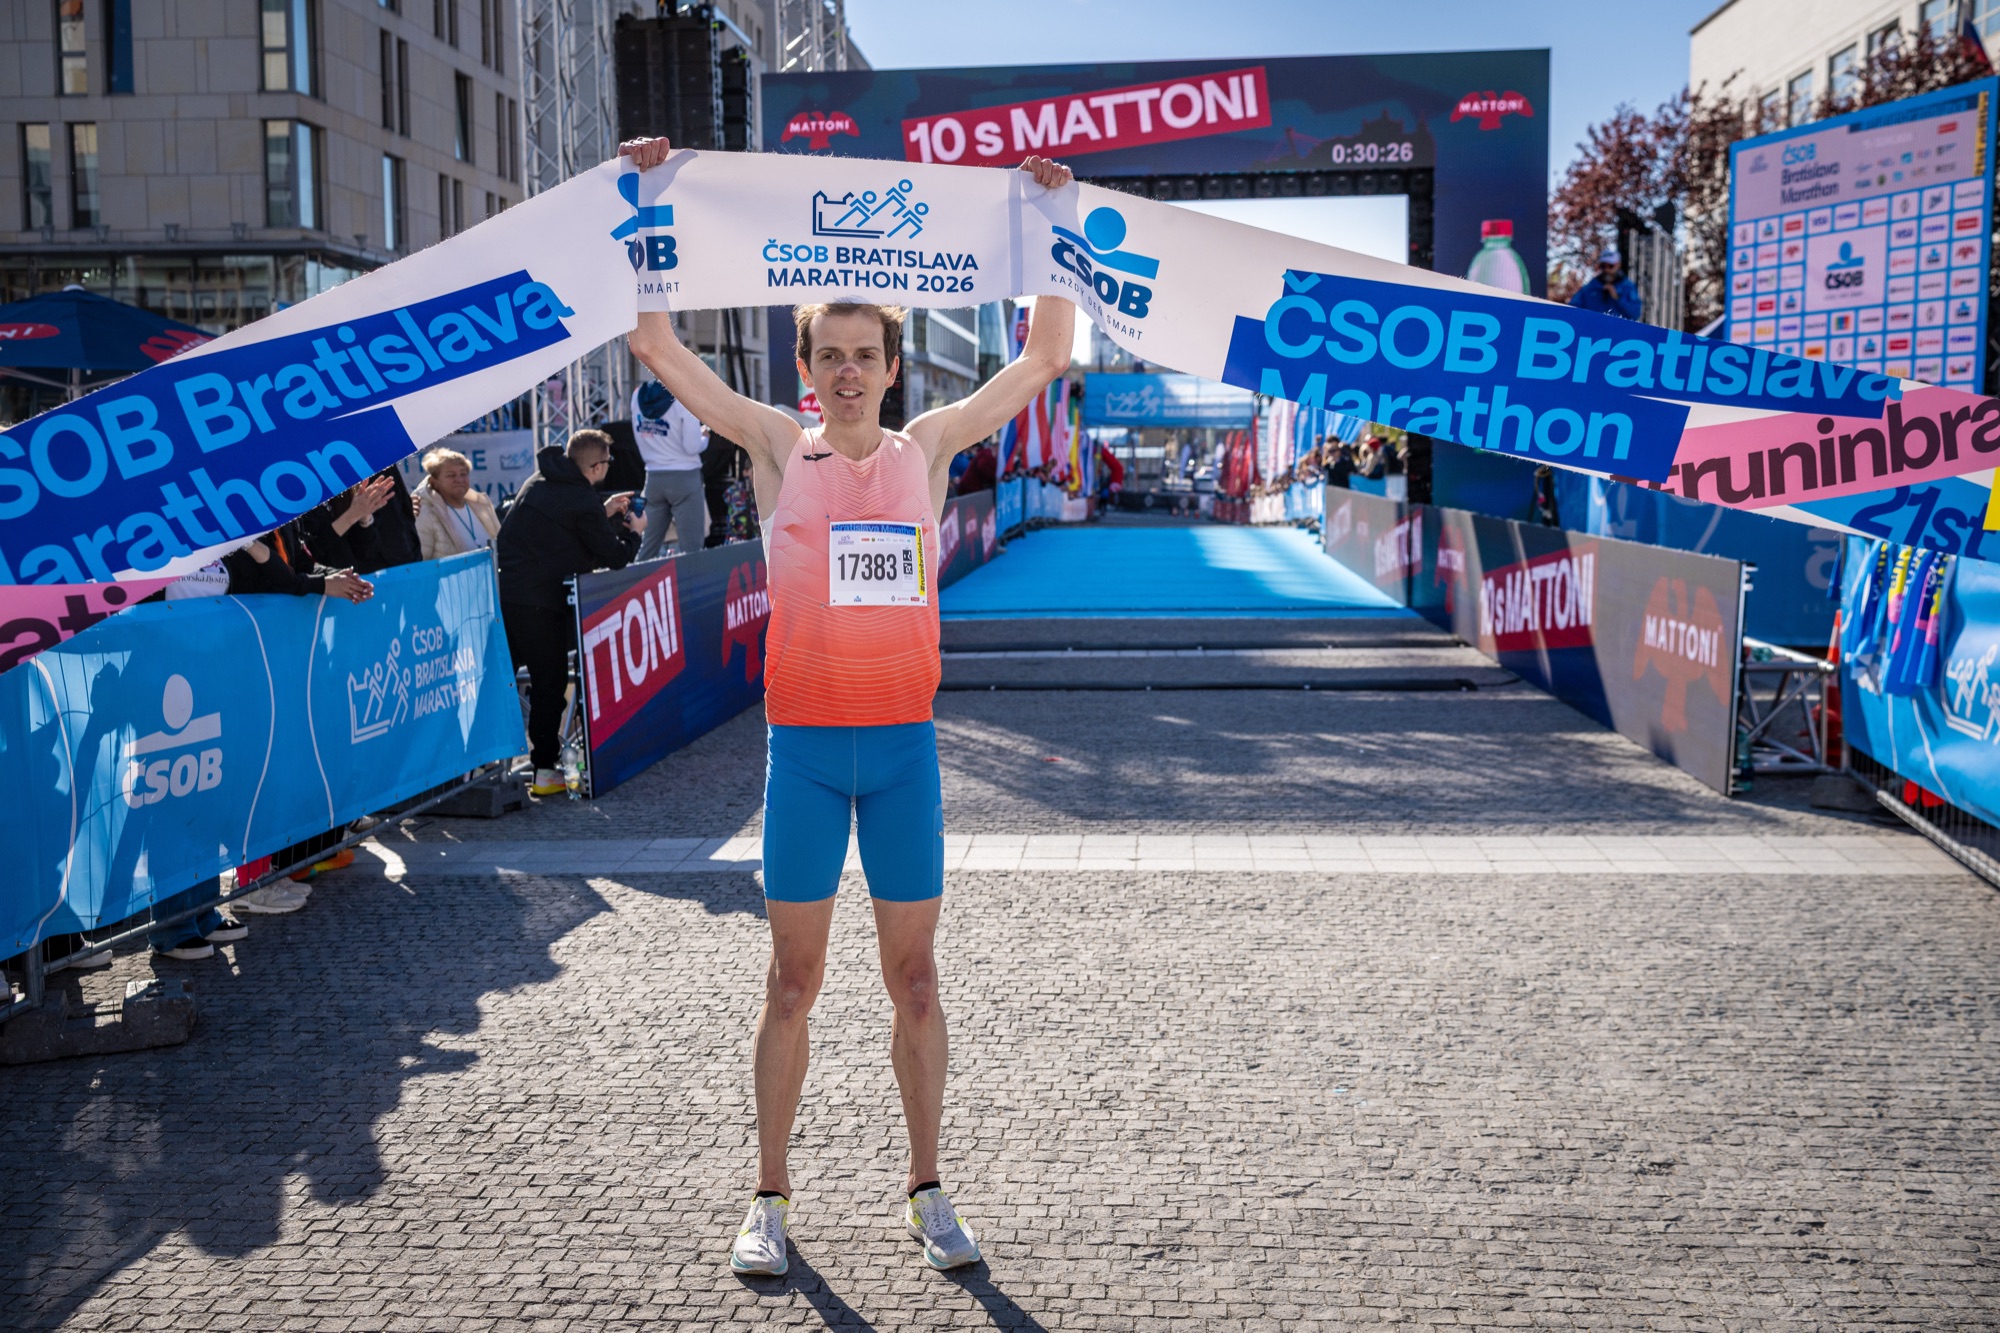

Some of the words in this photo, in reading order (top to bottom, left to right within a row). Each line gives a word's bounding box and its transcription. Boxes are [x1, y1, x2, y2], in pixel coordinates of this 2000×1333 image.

[789, 119, 851, 133] MATTONI
[909, 117, 966, 164] 10
[974, 121, 1005, 157] s
[1010, 73, 1259, 152] MATTONI
[1459, 98, 1525, 113] MATTONI
[1332, 142, 1414, 163] 0:30:26
[762, 238, 829, 263] ČSOB
[836, 246, 979, 271] BRATISLAVA
[1051, 237, 1153, 319] ČSOB
[767, 268, 909, 291] MARATHON
[916, 274, 975, 293] 2026
[1050, 273, 1085, 297] KAŽDÝ
[1106, 314, 1143, 340] SMART
[1264, 269, 1502, 374] ČSOB
[1515, 315, 1904, 402] Bratislava
[174, 280, 576, 454] Bratislava
[1611, 398, 2000, 504] runinbra
[0, 440, 373, 585] arathon
[837, 553, 897, 581] 17383
[412, 624, 444, 656] ČSOB
[1644, 615, 1719, 668] MATTONI
[414, 647, 477, 690] BRATISLAVA
[413, 676, 477, 721] MARATHON
[122, 747, 223, 810] ČSOB
